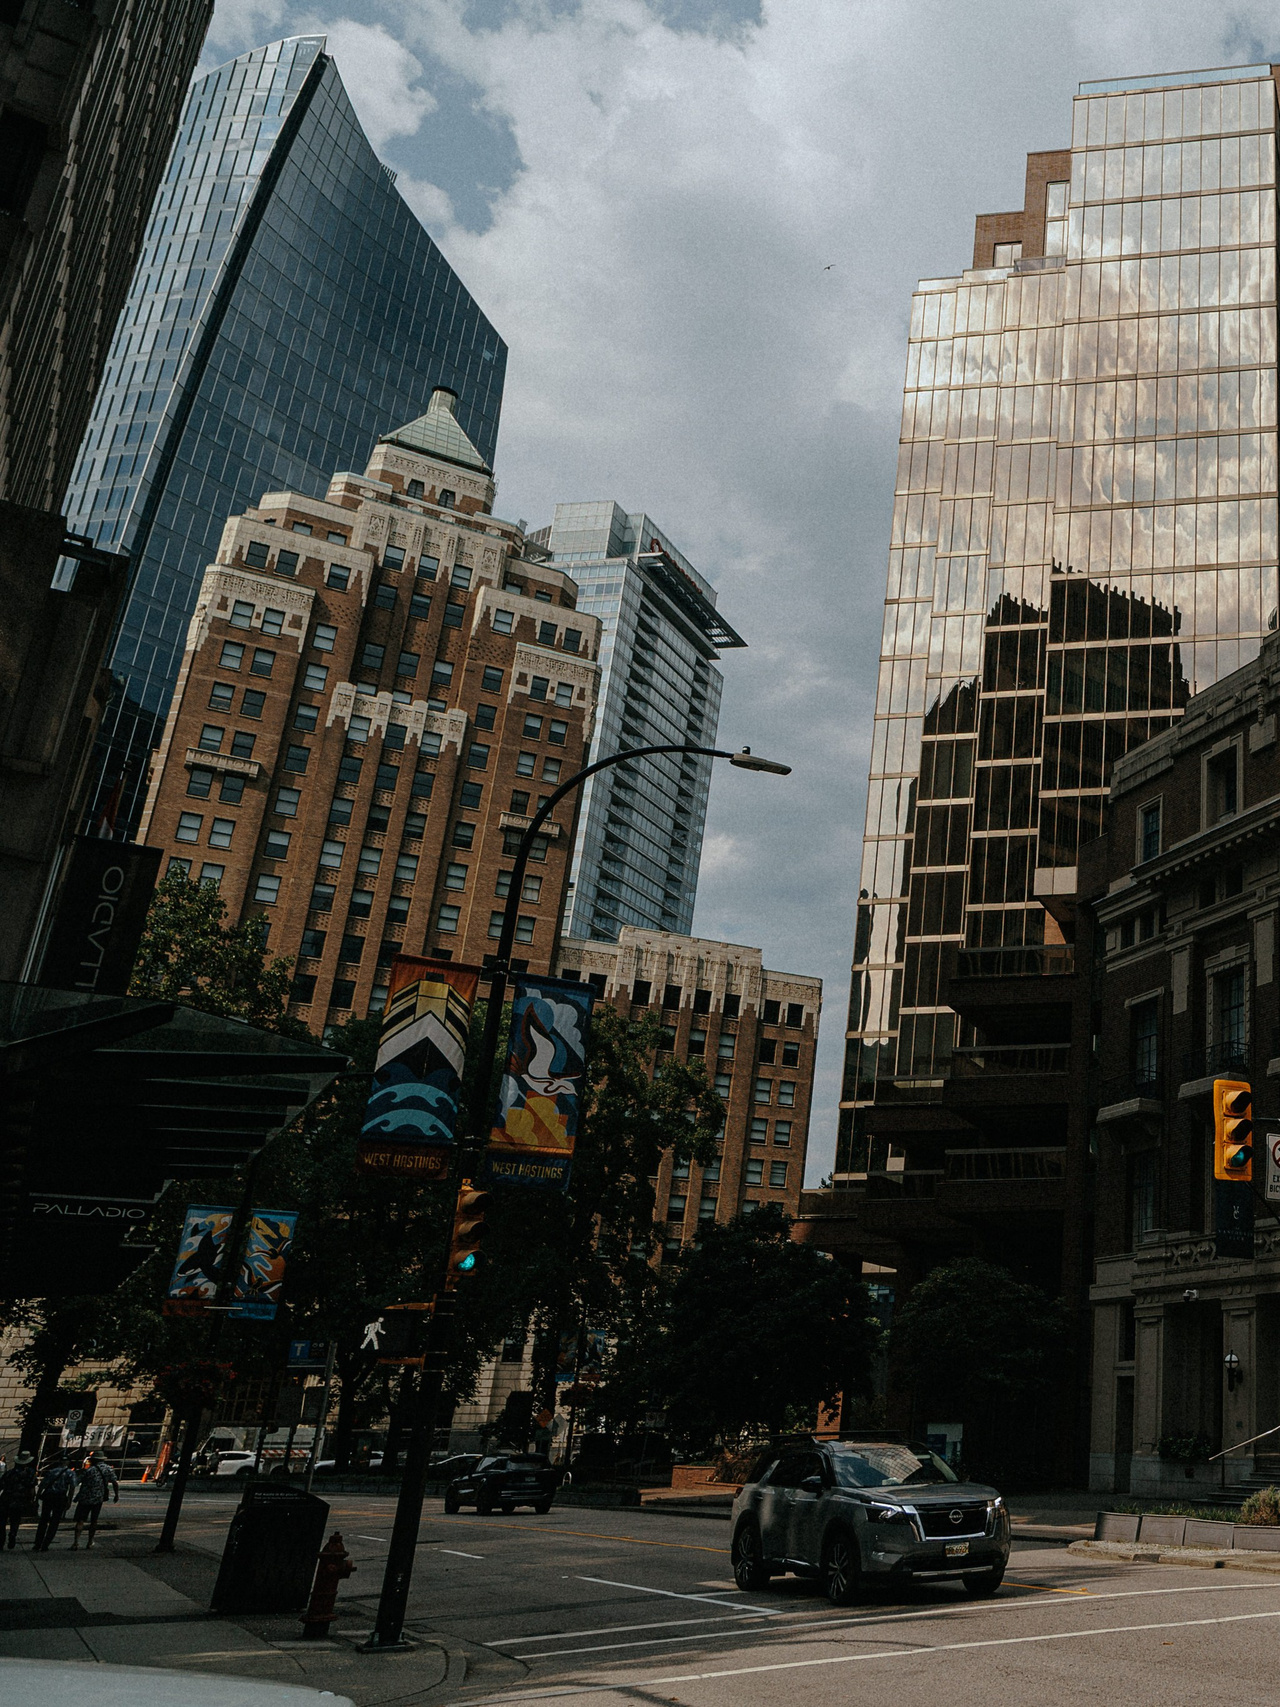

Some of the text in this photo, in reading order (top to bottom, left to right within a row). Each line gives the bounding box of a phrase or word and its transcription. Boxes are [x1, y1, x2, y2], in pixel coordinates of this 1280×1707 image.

[75, 866, 125, 991] LLADIO
[364, 1152, 442, 1170] WEST HASTINGS
[492, 1161, 564, 1179] WEST HASTINGS
[32, 1202, 146, 1219] PALLADIO
